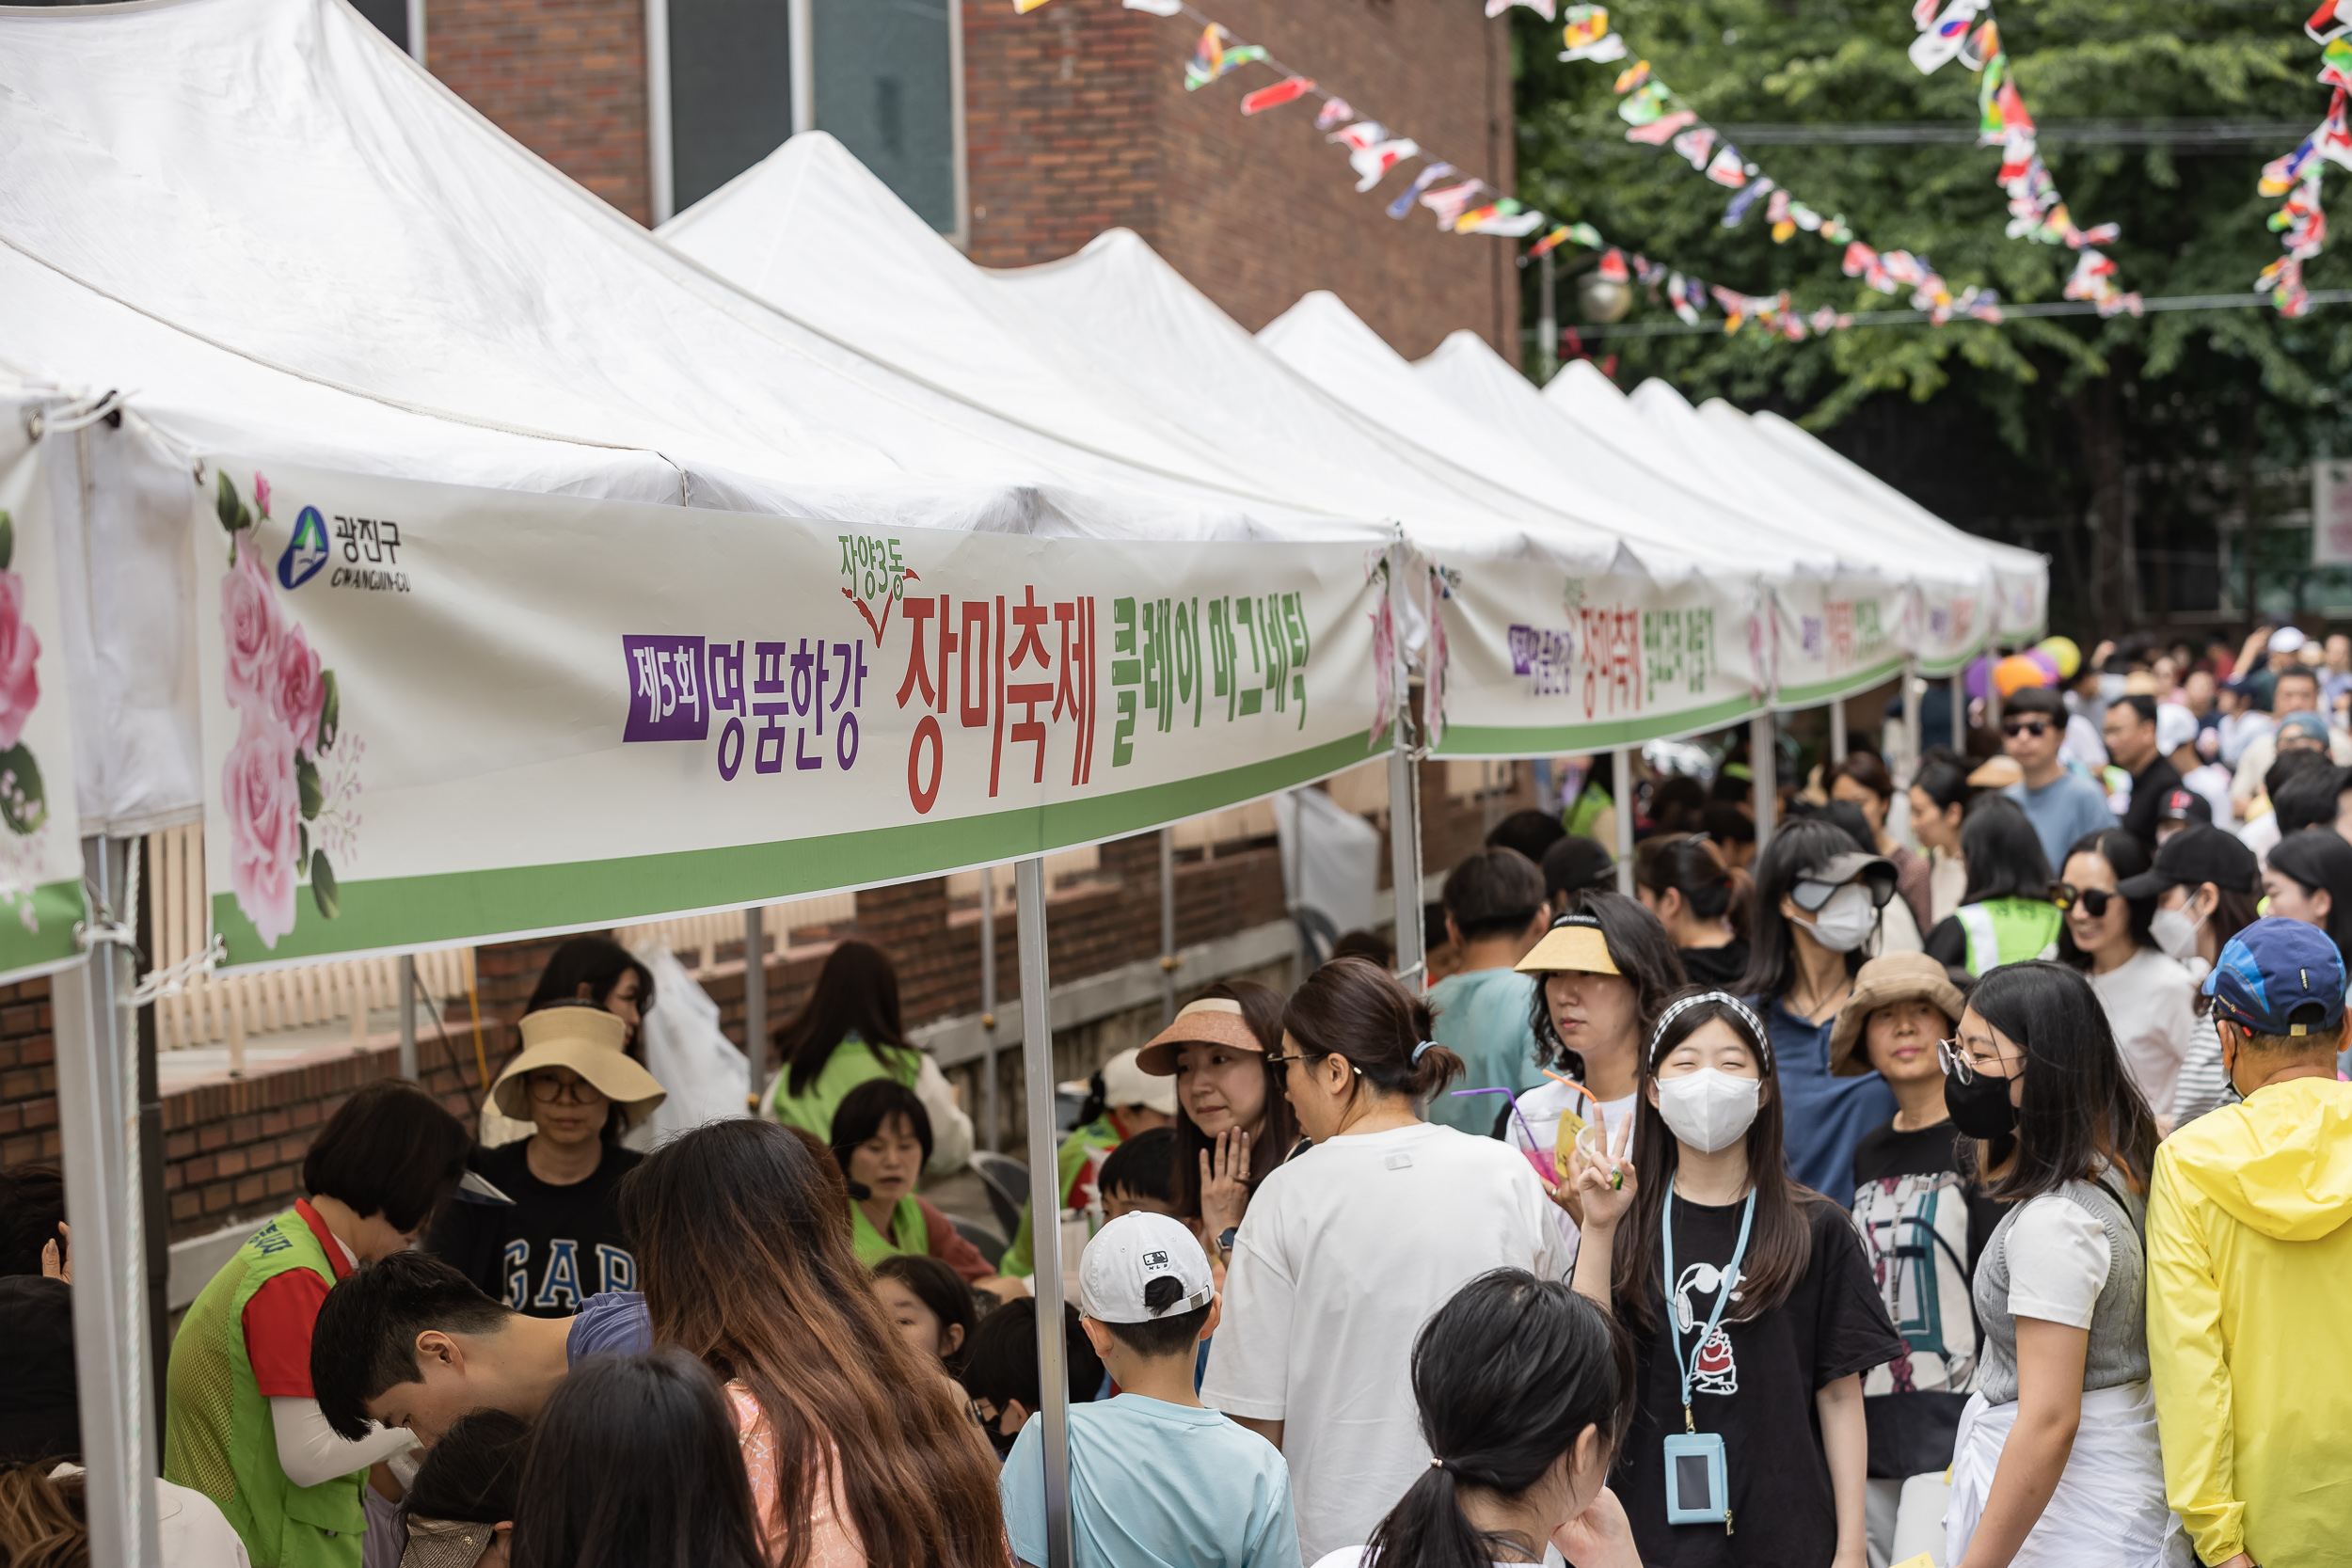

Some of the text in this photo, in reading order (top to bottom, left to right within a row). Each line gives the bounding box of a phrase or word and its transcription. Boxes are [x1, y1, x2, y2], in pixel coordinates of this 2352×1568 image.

[335, 515, 402, 565] 광진구
[837, 534, 905, 601] 자양3동
[632, 584, 1311, 815] 제5회 명품한강 장미축제 클레이 마그네틱
[501, 1238, 637, 1312] GAP
